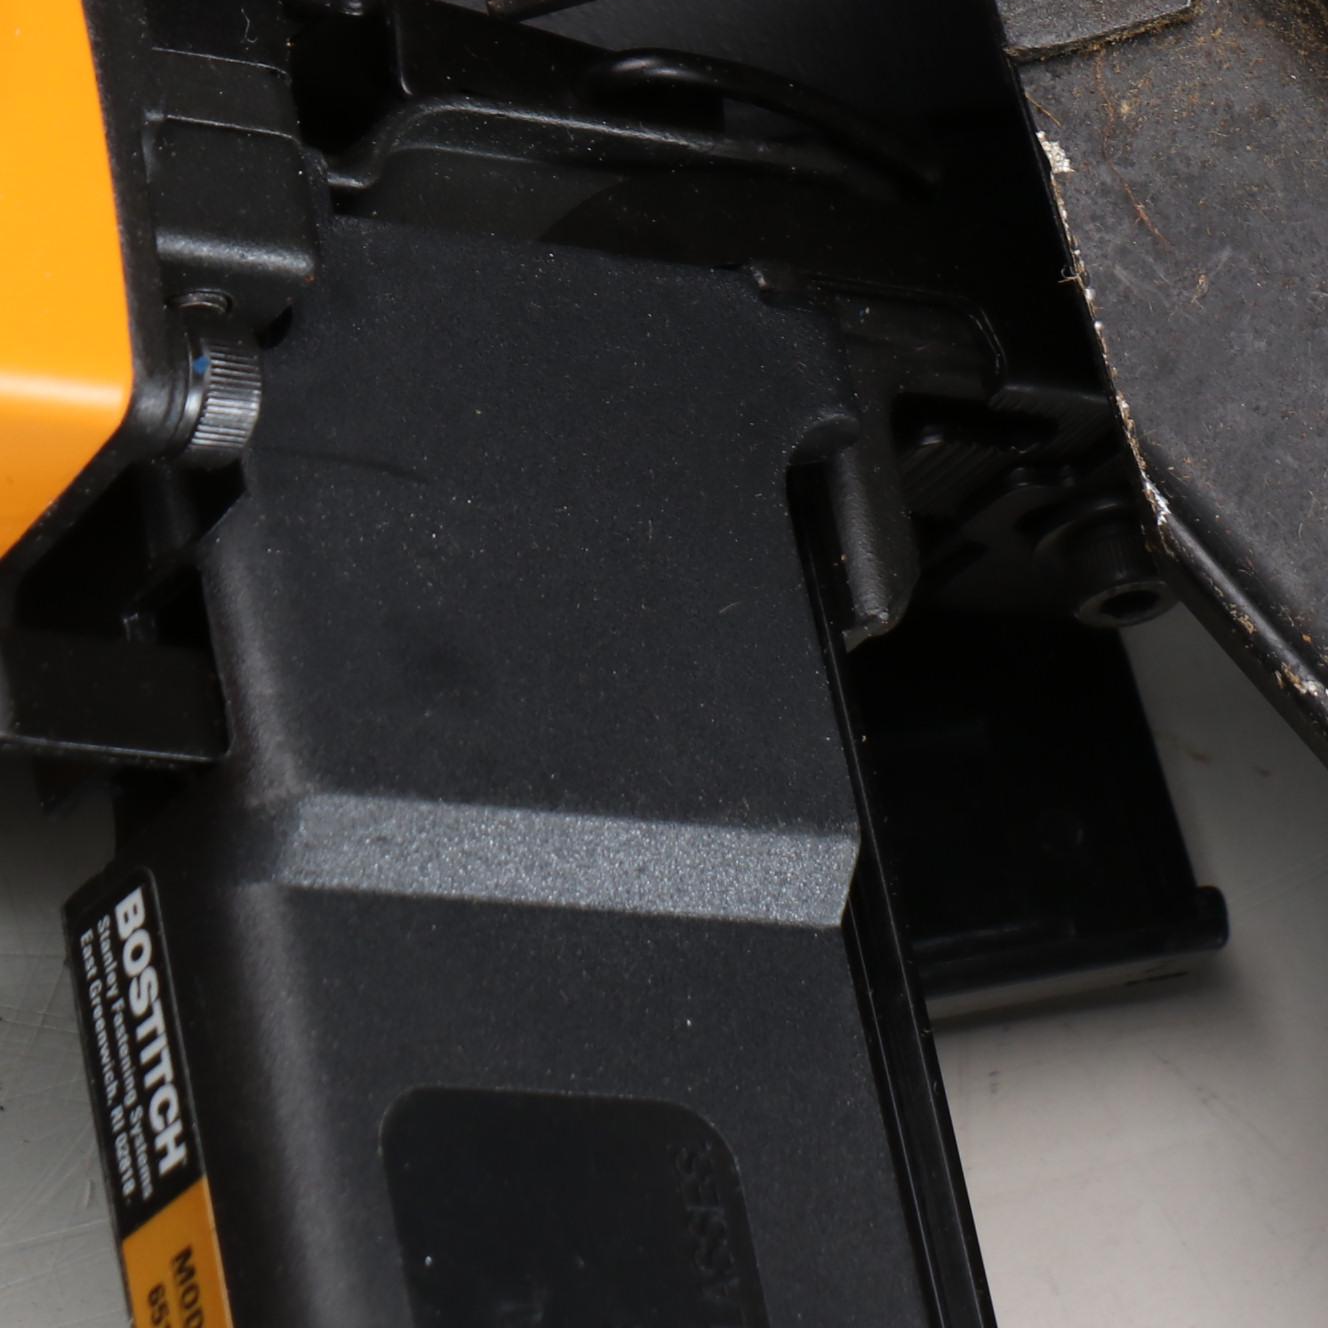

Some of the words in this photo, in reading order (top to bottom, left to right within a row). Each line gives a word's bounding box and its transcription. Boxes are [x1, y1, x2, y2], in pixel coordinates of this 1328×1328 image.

[80, 928, 97, 981] East
[111, 1104, 125, 1133] RI
[97, 914, 120, 998] Stanley
[111, 997, 137, 1107] Fastening
[129, 1104, 153, 1200] Systems
[114, 886, 187, 1175] BOSTITCH
[147, 1282, 173, 1328] 65
